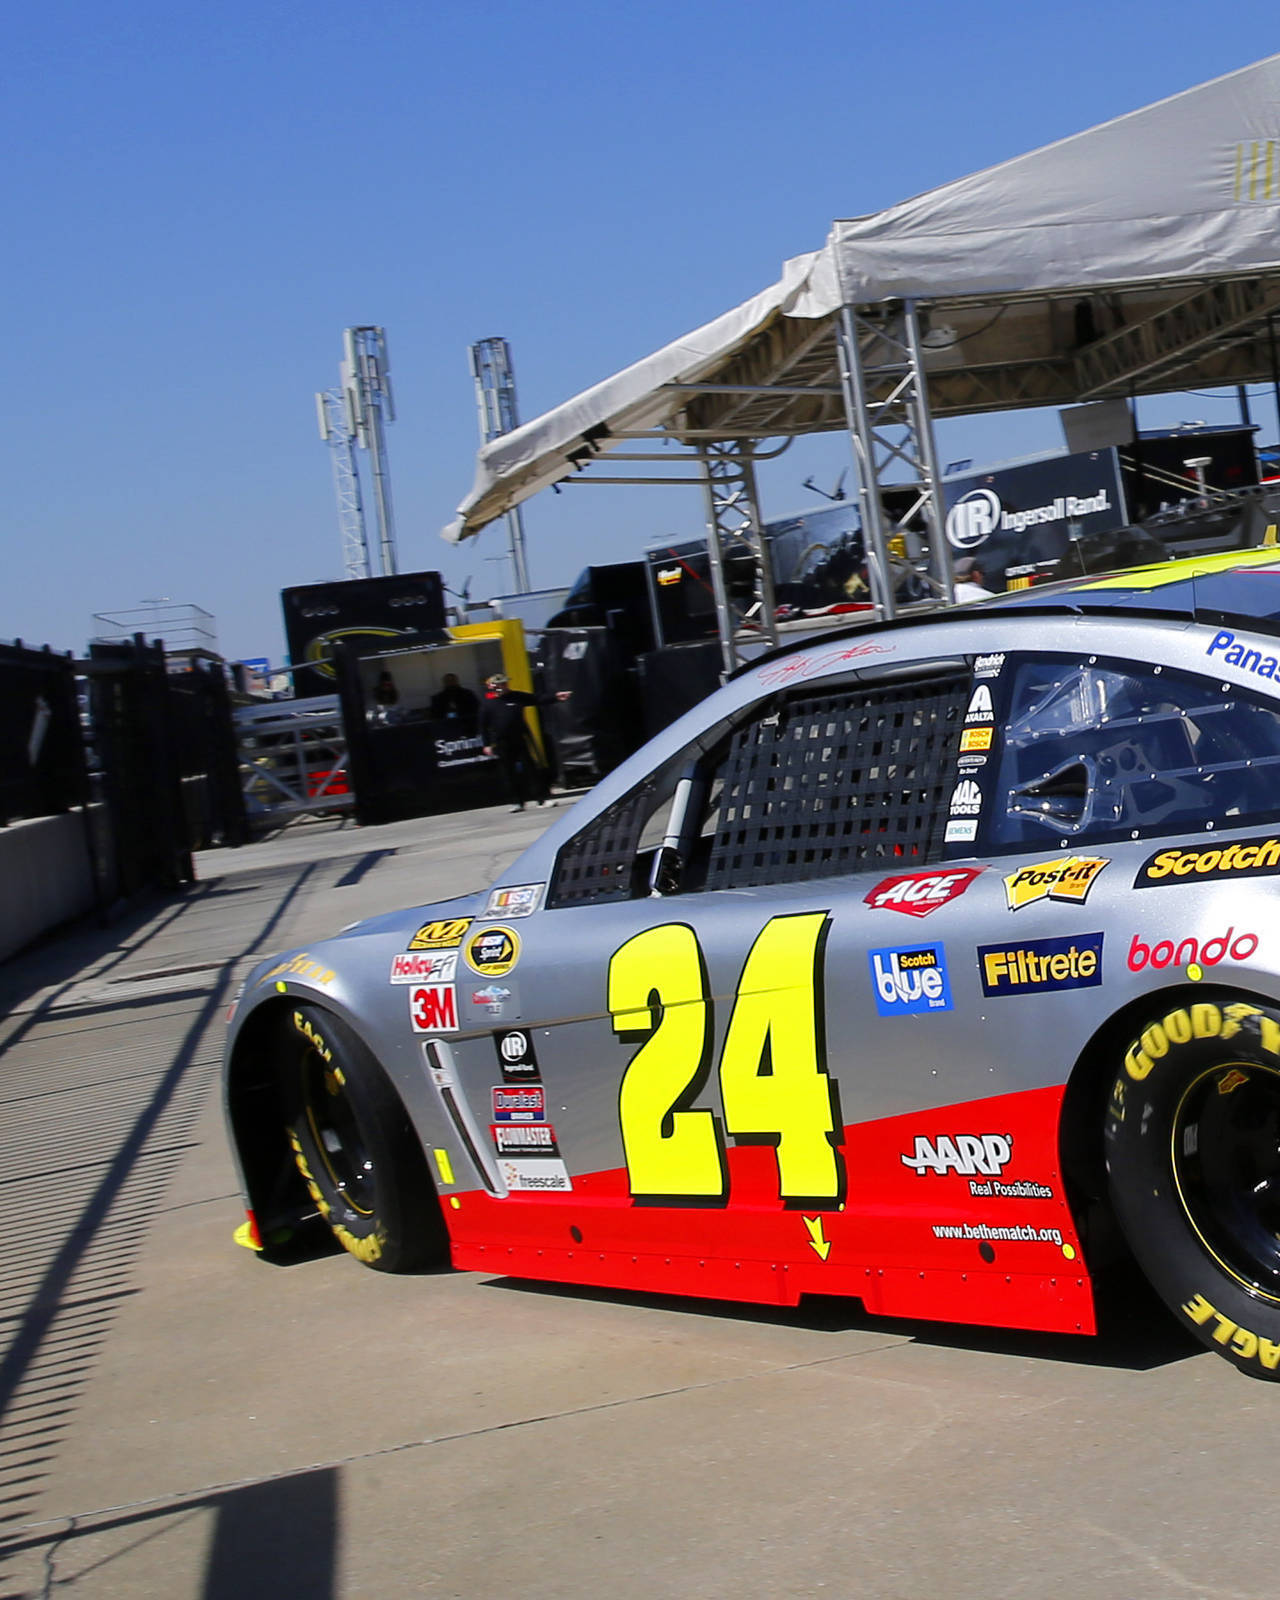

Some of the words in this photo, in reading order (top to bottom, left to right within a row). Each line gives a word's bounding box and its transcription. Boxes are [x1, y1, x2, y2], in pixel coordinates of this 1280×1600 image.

[1001, 497, 1065, 533] Ingersoll
[964, 711, 995, 723] AXALTA
[950, 779, 982, 806] MAC
[949, 804, 980, 816] TOOLS
[1012, 862, 1096, 888] Post-it
[875, 873, 968, 905] ACE
[900, 953, 936, 968] Scotch
[1127, 927, 1259, 972] bondo
[393, 956, 433, 981] Holley
[873, 952, 944, 1003] blue
[984, 945, 1098, 987] Filtrete
[414, 988, 456, 1029] 3M
[608, 910, 842, 1205] 24
[495, 1090, 543, 1109] Duralast
[902, 1134, 1011, 1175] AARP
[518, 1174, 567, 1188] freescale
[969, 1181, 993, 1196] Real
[994, 1181, 1052, 1198] Possibilities
[932, 1223, 1063, 1246] www.bethematch.org
